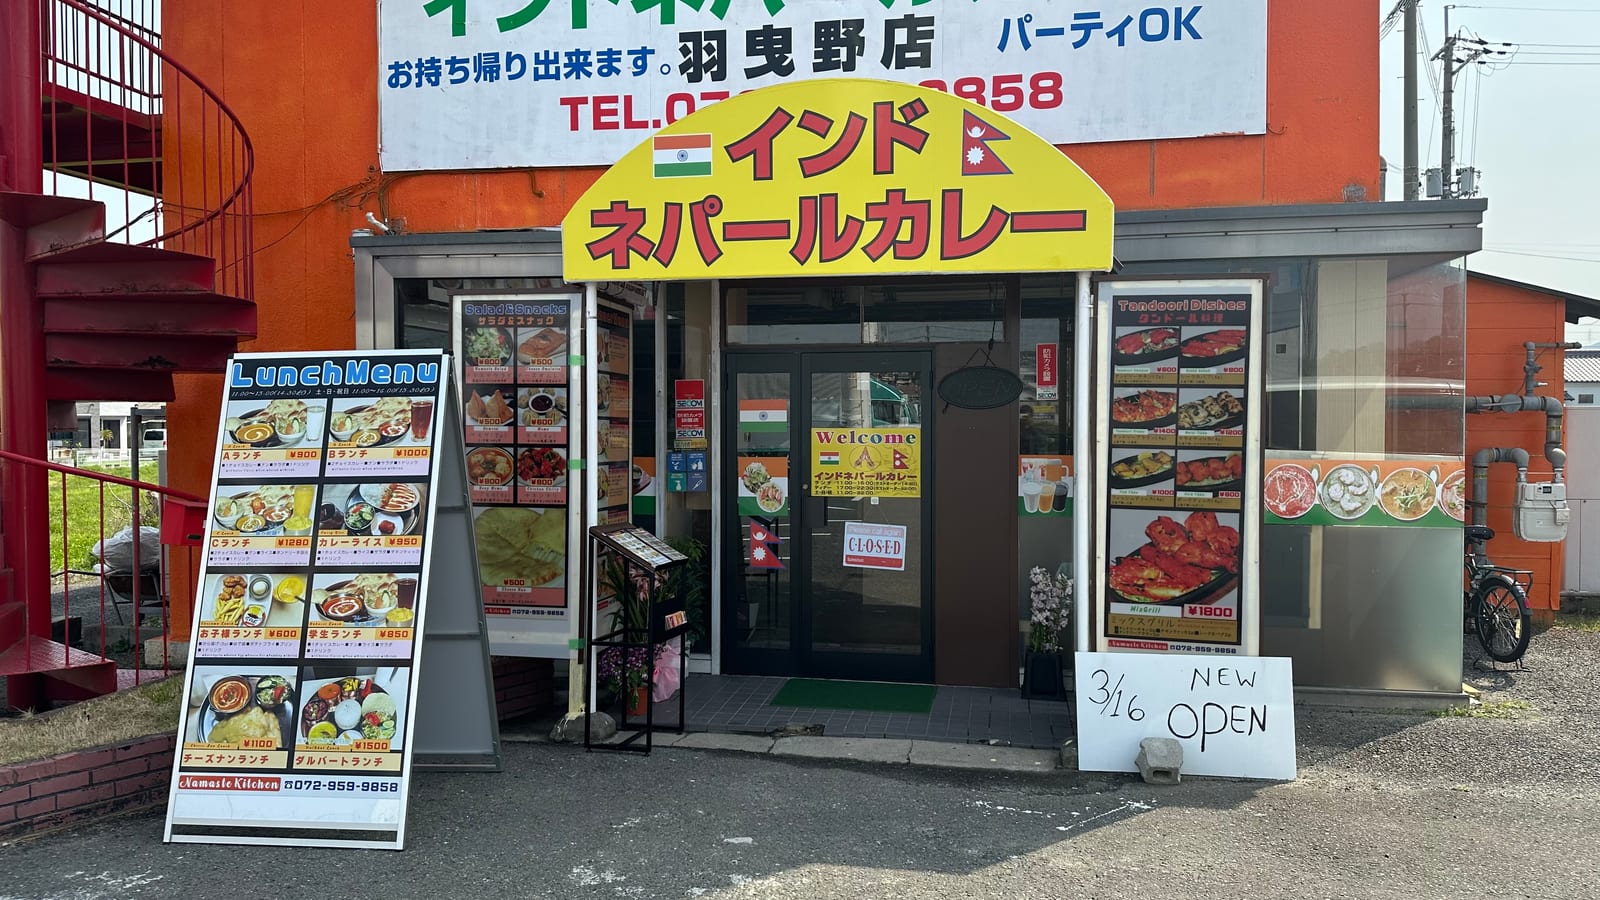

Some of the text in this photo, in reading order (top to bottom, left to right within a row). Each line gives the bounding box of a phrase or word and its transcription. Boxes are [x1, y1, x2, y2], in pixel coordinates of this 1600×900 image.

[996, 5, 1204, 54] パーティOK
[678, 14, 936, 83] 羽曳野店
[386, 46, 672, 89] お持ち帰り出来ます。
[723, 97, 930, 182] インド
[585, 187, 1088, 271] ネパールカレー
[465, 303, 568, 315] Salad&Snacks
[1117, 298, 1247, 312] Tandoori Dishes
[815, 430, 917, 445] Welcome
[222, 450, 262, 461] Aランチ
[290, 450, 317, 459] ¥900
[328, 449, 368, 459] Bランチ
[395, 448, 428, 457] ¥1000
[211, 538, 251, 548] Cランチ
[277, 538, 309, 547] ¥1280
[319, 538, 382, 548] カレーライス
[389, 537, 418, 546] ¥950
[1188, 606, 1233, 618] ¥1800
[1112, 615, 1175, 628] ミックスグリル
[199, 628, 262, 639] お子様ランチ
[269, 629, 298, 638] ¥600
[308, 629, 362, 639] 学生ランチ
[379, 629, 409, 638] ¥850
[1190, 667, 1256, 691] NEW
[1088, 669, 1146, 722] 3/16
[1167, 702, 1267, 753] OPEN
[242, 738, 273, 749] ¥1100
[354, 740, 389, 751] ¥1500
[183, 752, 270, 765] チーズナンランチ
[295, 755, 384, 768] ダルバートランチ
[179, 775, 399, 793] Namaste Kitchen 072-959-9858
